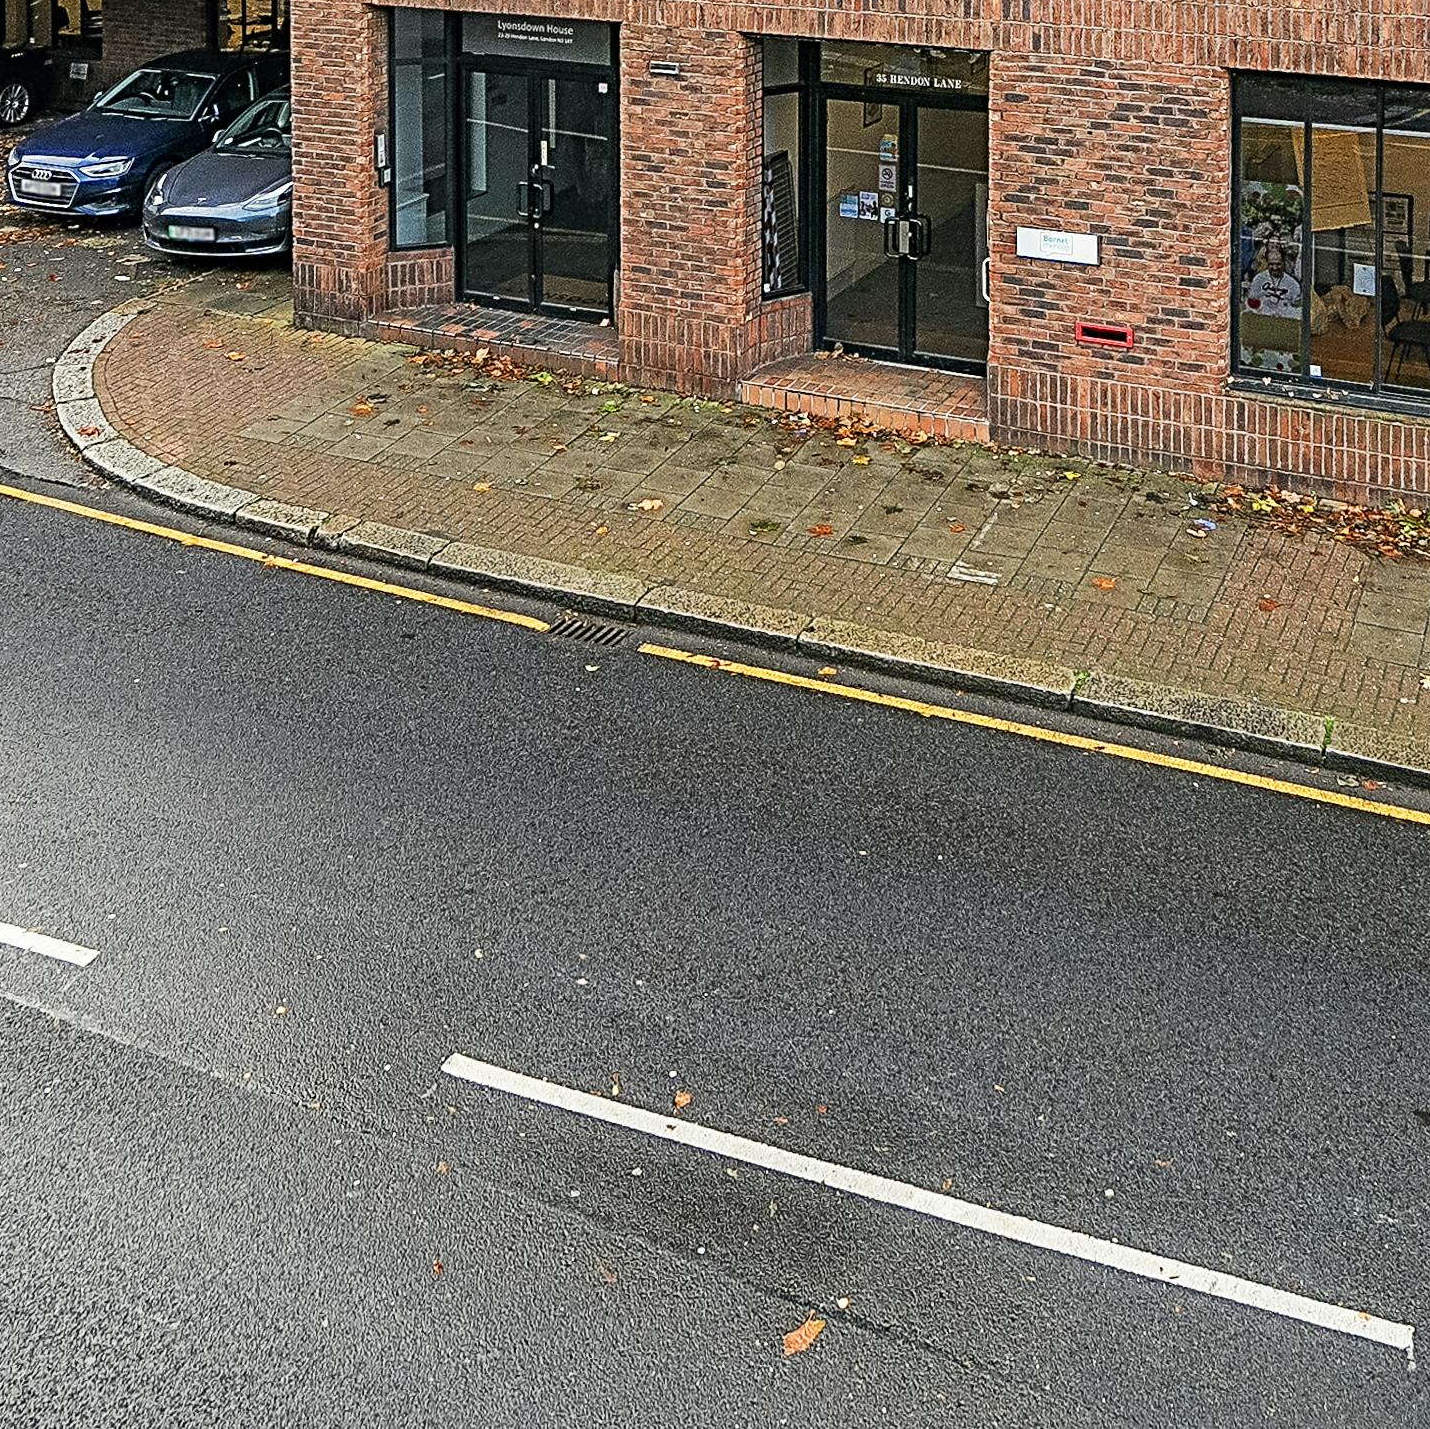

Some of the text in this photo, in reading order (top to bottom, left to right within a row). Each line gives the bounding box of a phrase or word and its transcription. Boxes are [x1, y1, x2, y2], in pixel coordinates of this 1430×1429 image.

[497, 20, 574, 35] Lyonsdown House
[876, 73, 962, 89] 35 HENDON LANE
[1043, 234, 1069, 245] Barnet
